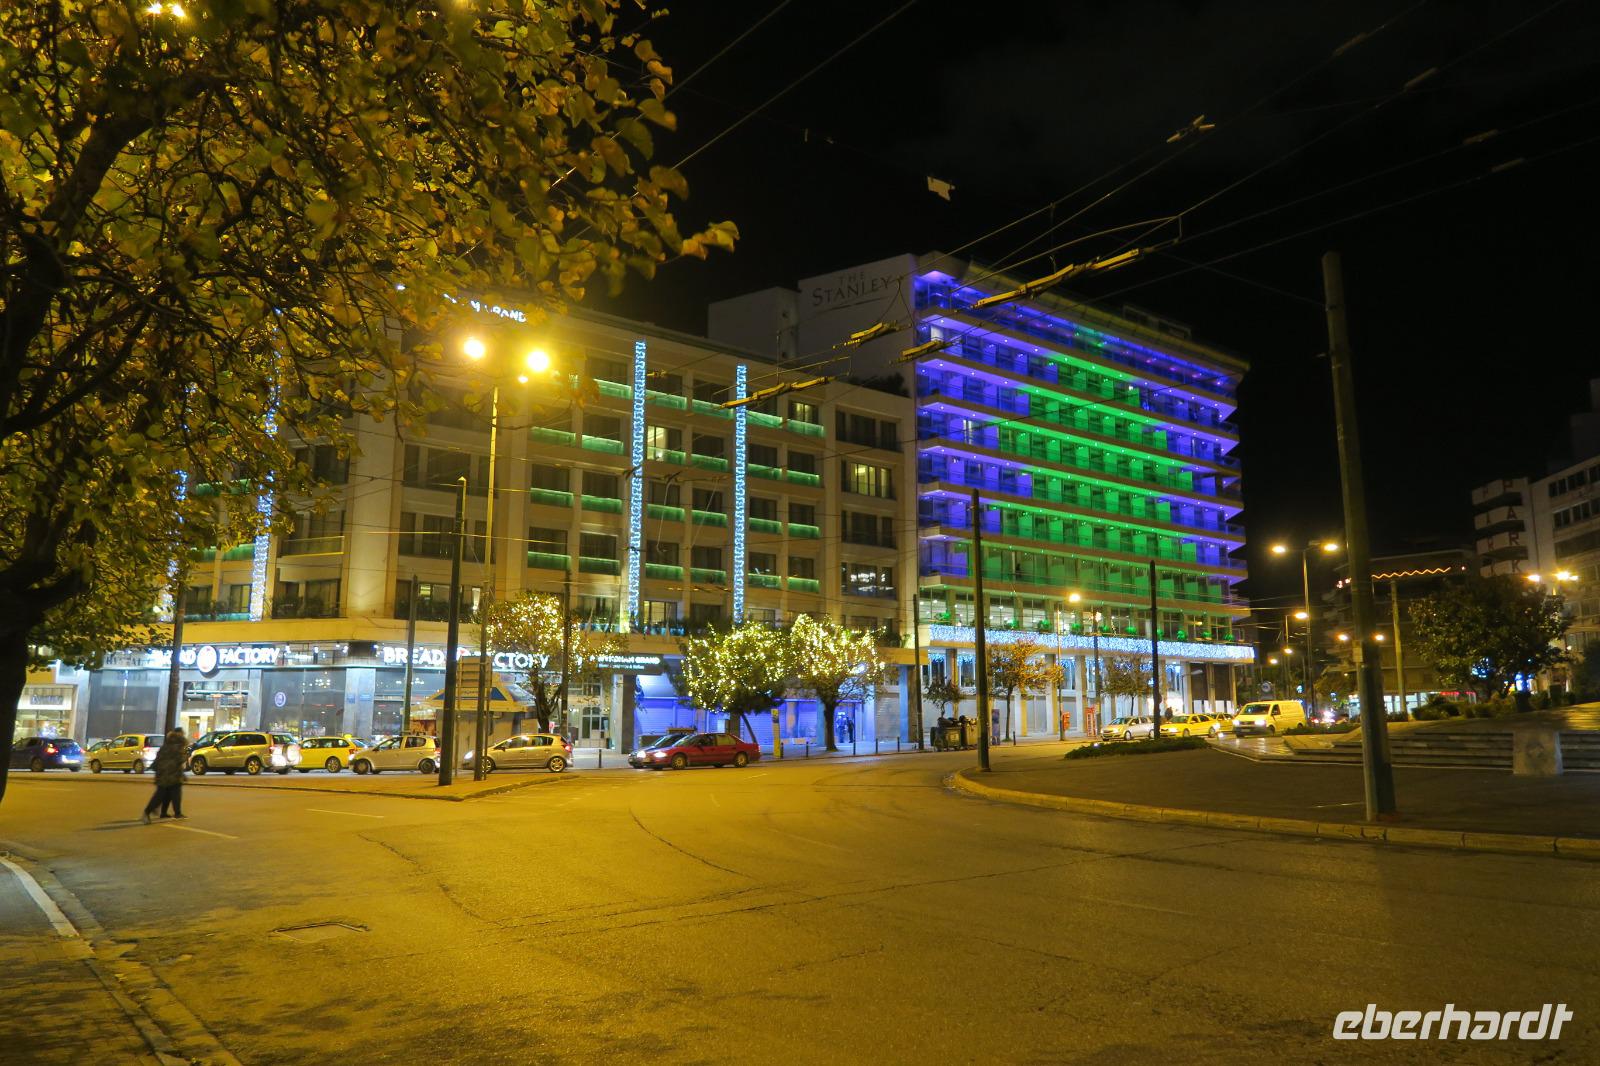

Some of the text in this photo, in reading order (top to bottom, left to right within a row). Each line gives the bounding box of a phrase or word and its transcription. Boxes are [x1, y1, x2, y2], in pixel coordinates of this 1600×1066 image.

[838, 272, 866, 286] THE
[812, 276, 892, 307] STANLEY
[218, 647, 281, 665] FACTORY
[383, 646, 446, 665] BREAD
